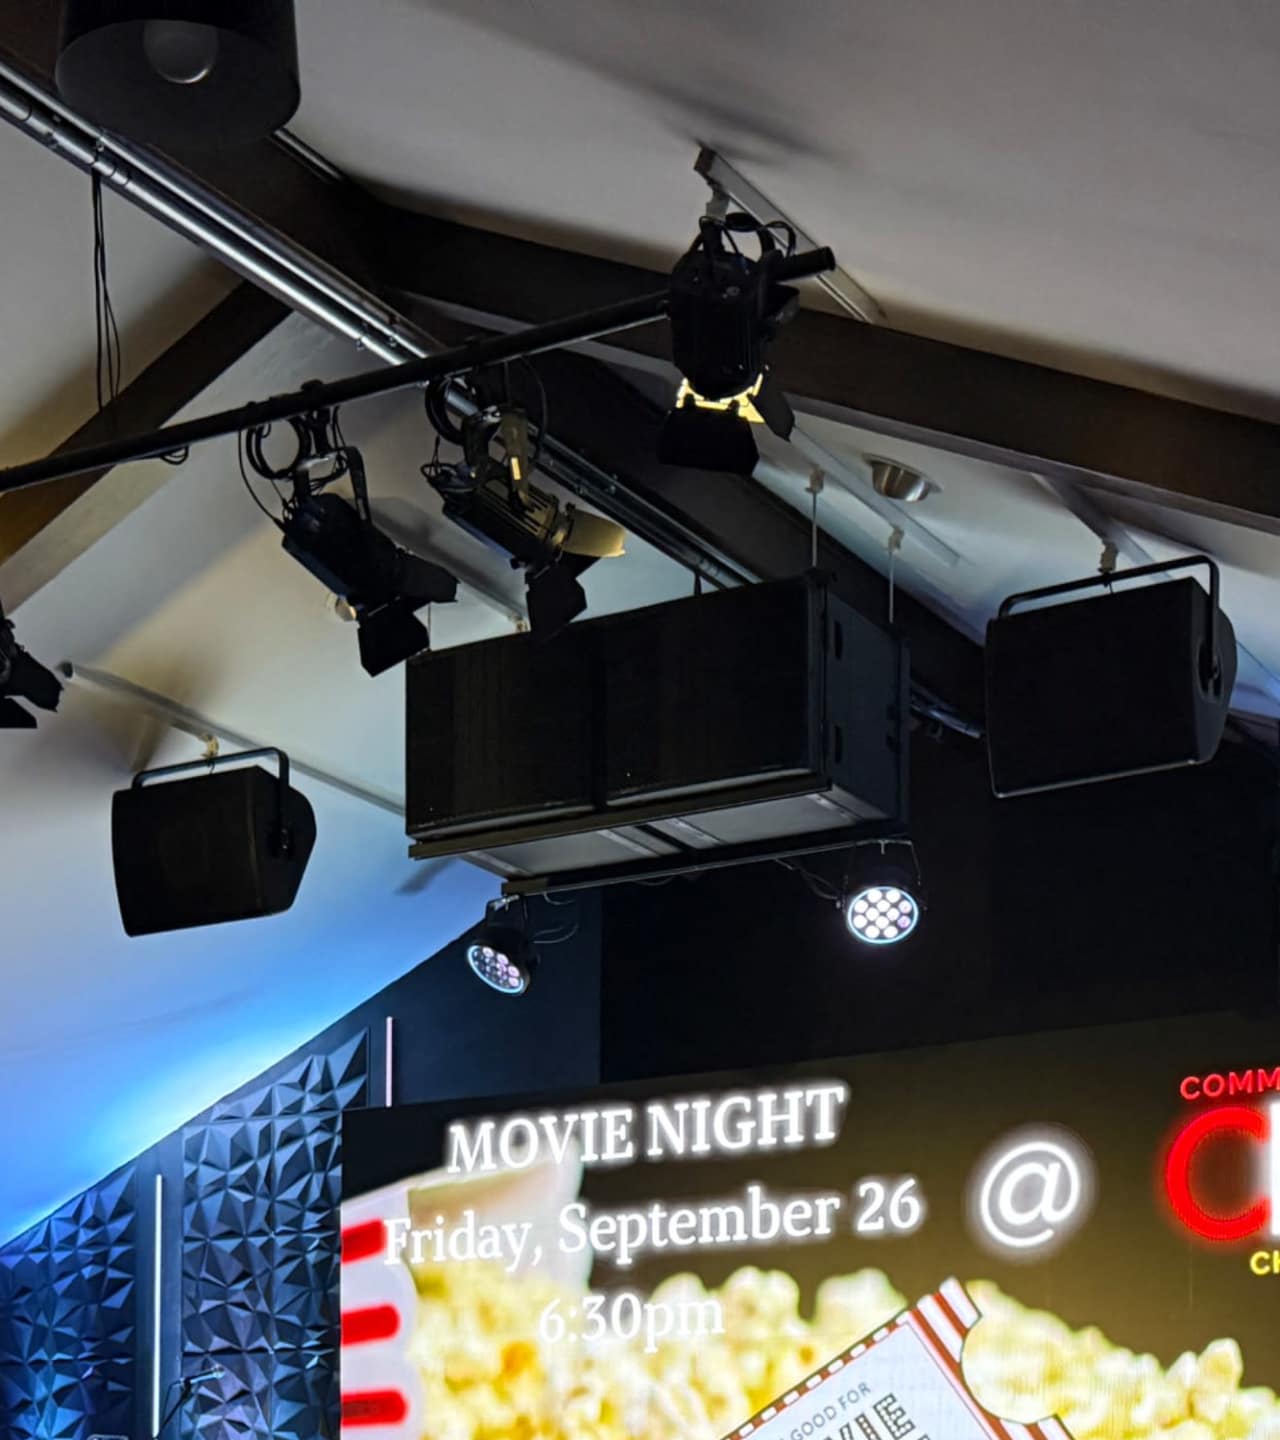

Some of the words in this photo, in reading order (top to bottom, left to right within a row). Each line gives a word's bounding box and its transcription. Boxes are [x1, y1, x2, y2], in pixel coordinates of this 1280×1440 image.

[447, 1108, 634, 1173] MOVIE
[646, 1086, 847, 1159] NIGHT
[382, 1208, 544, 1273] Friday,
[558, 1185, 840, 1264] September
[855, 1177, 921, 1233] 26
[979, 1140, 1081, 1248] @
[538, 1291, 725, 1353] 6:30pm
[839, 1381, 872, 1411] FOR
